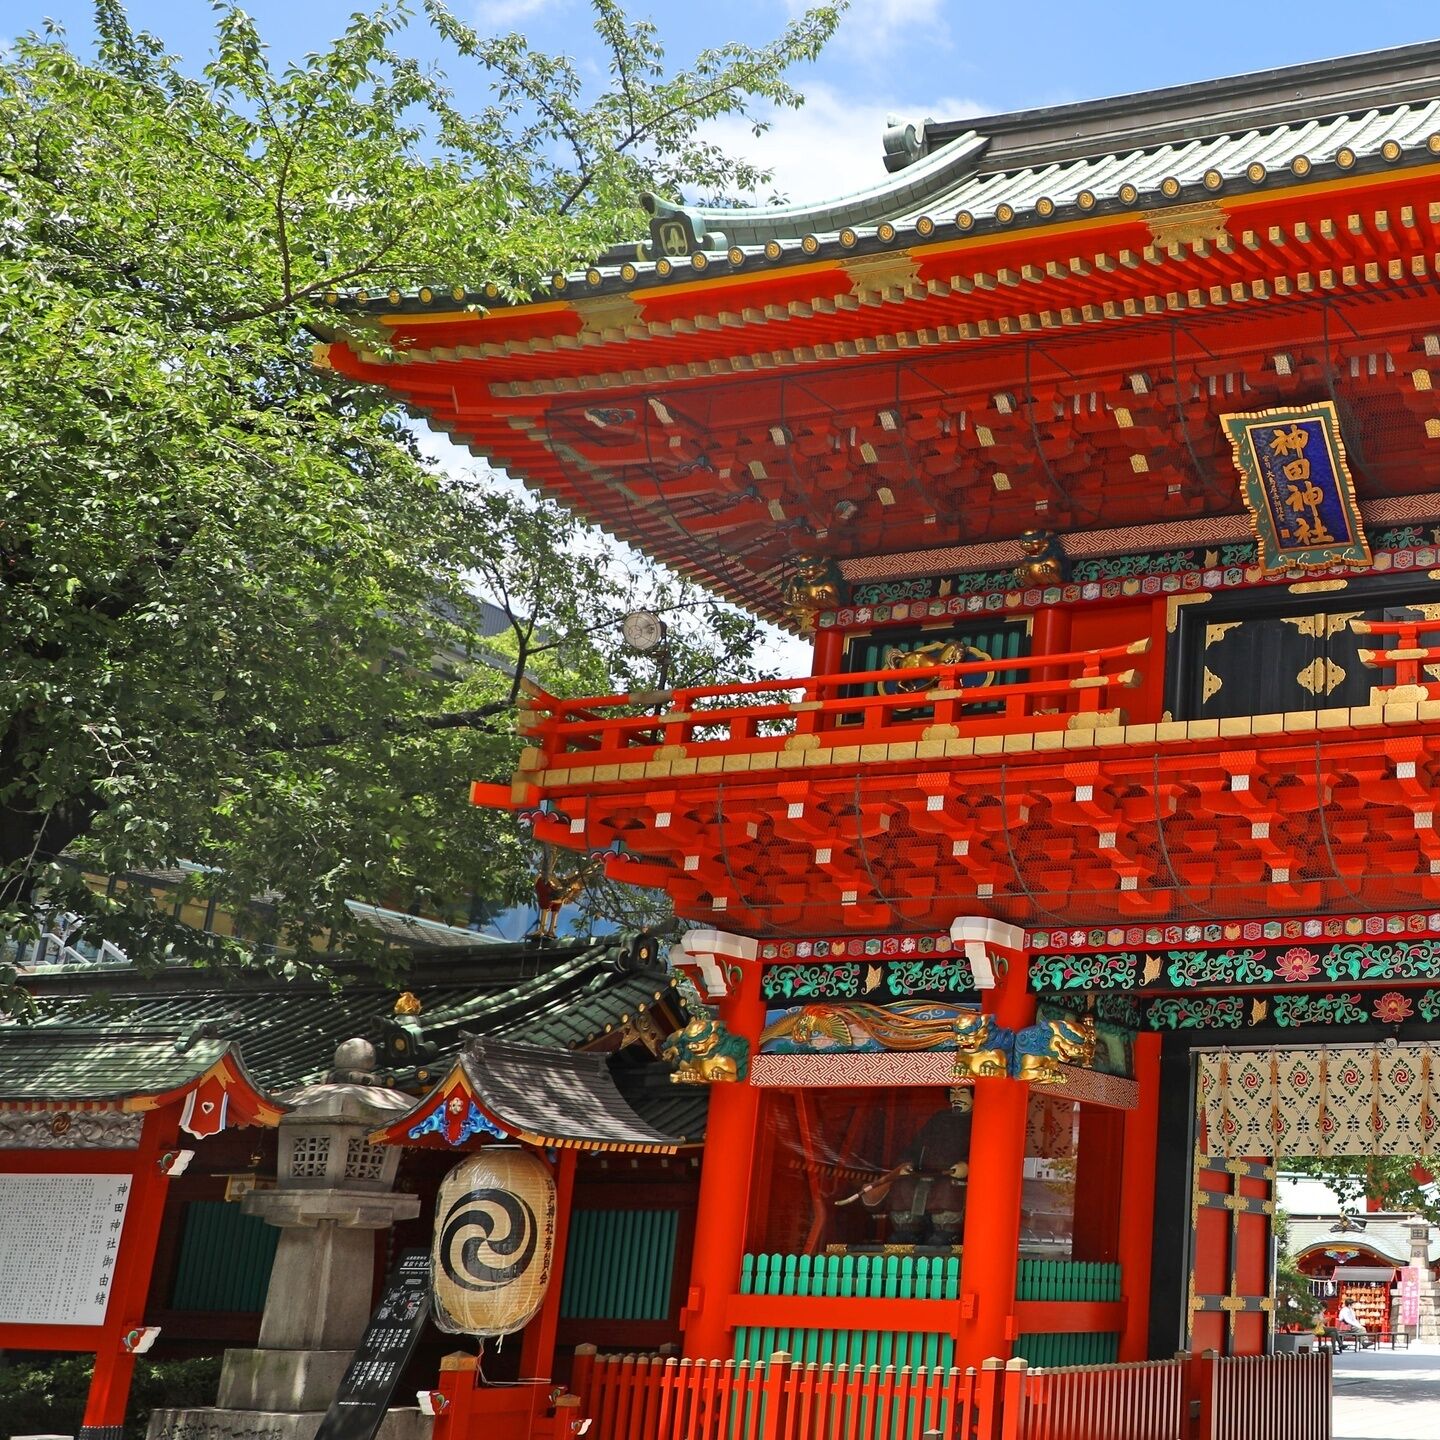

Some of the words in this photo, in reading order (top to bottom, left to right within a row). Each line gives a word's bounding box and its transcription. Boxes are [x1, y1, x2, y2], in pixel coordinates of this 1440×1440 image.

[1269, 424, 1335, 546] 神田神社
[94, 1182, 128, 1306] 神田神社御由緒
